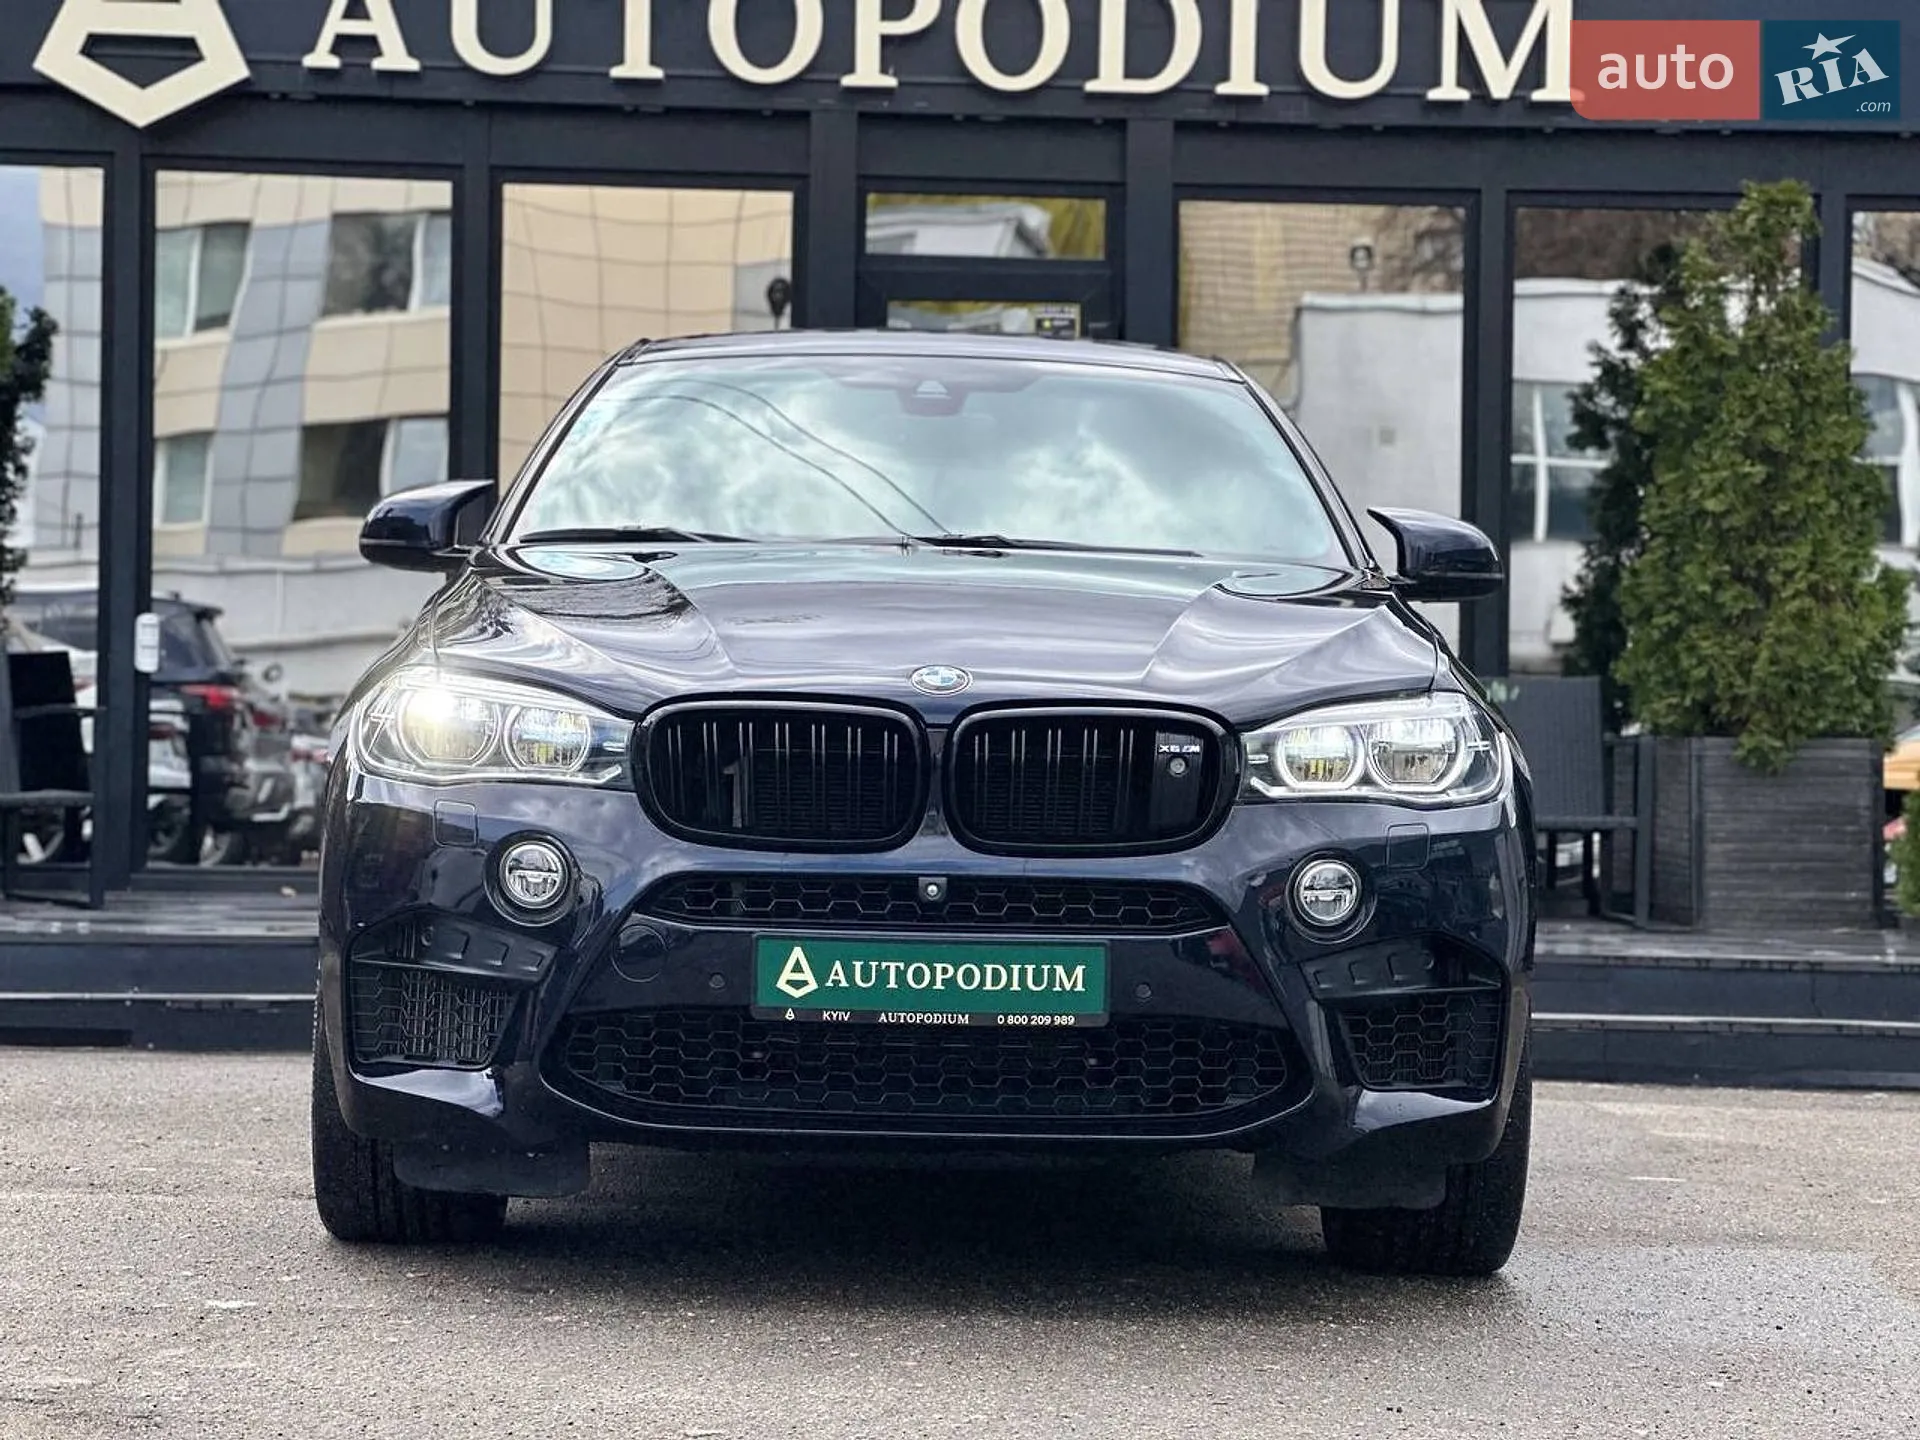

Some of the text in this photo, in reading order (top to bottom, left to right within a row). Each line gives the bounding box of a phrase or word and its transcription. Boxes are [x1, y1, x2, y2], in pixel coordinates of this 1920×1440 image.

[824, 960, 1086, 993] AUTOPODIUM
[822, 1010, 851, 1022] KYIV
[878, 1012, 969, 1025] AUTOPODIUM
[997, 1014, 1005, 1025] 0
[1006, 1014, 1028, 1025] 800
[1030, 1015, 1051, 1026] 209
